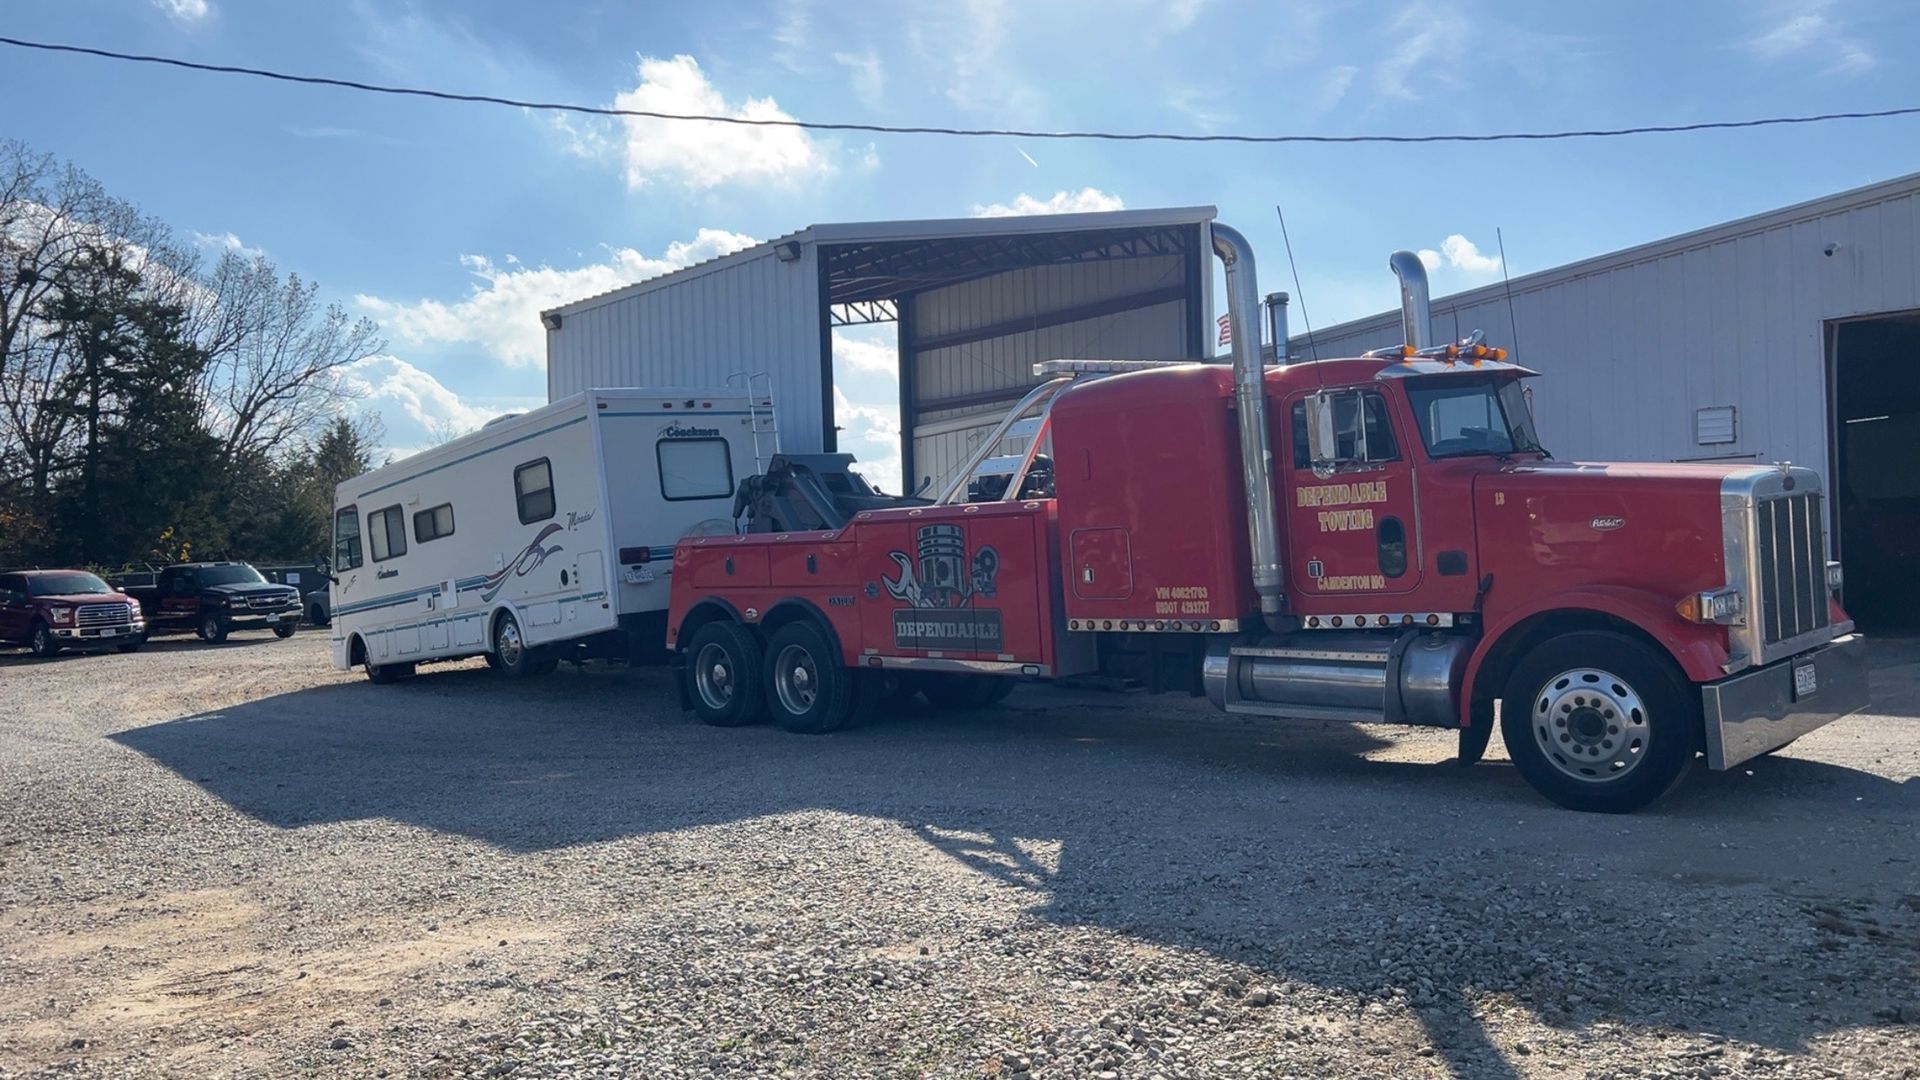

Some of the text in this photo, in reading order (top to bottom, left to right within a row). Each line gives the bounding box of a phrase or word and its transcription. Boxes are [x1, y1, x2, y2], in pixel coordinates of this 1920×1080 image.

[1296, 481, 1387, 507] DEPENDABLE
[1318, 509, 1374, 532] TOWING
[896, 622, 999, 639] DEPENDABLE
